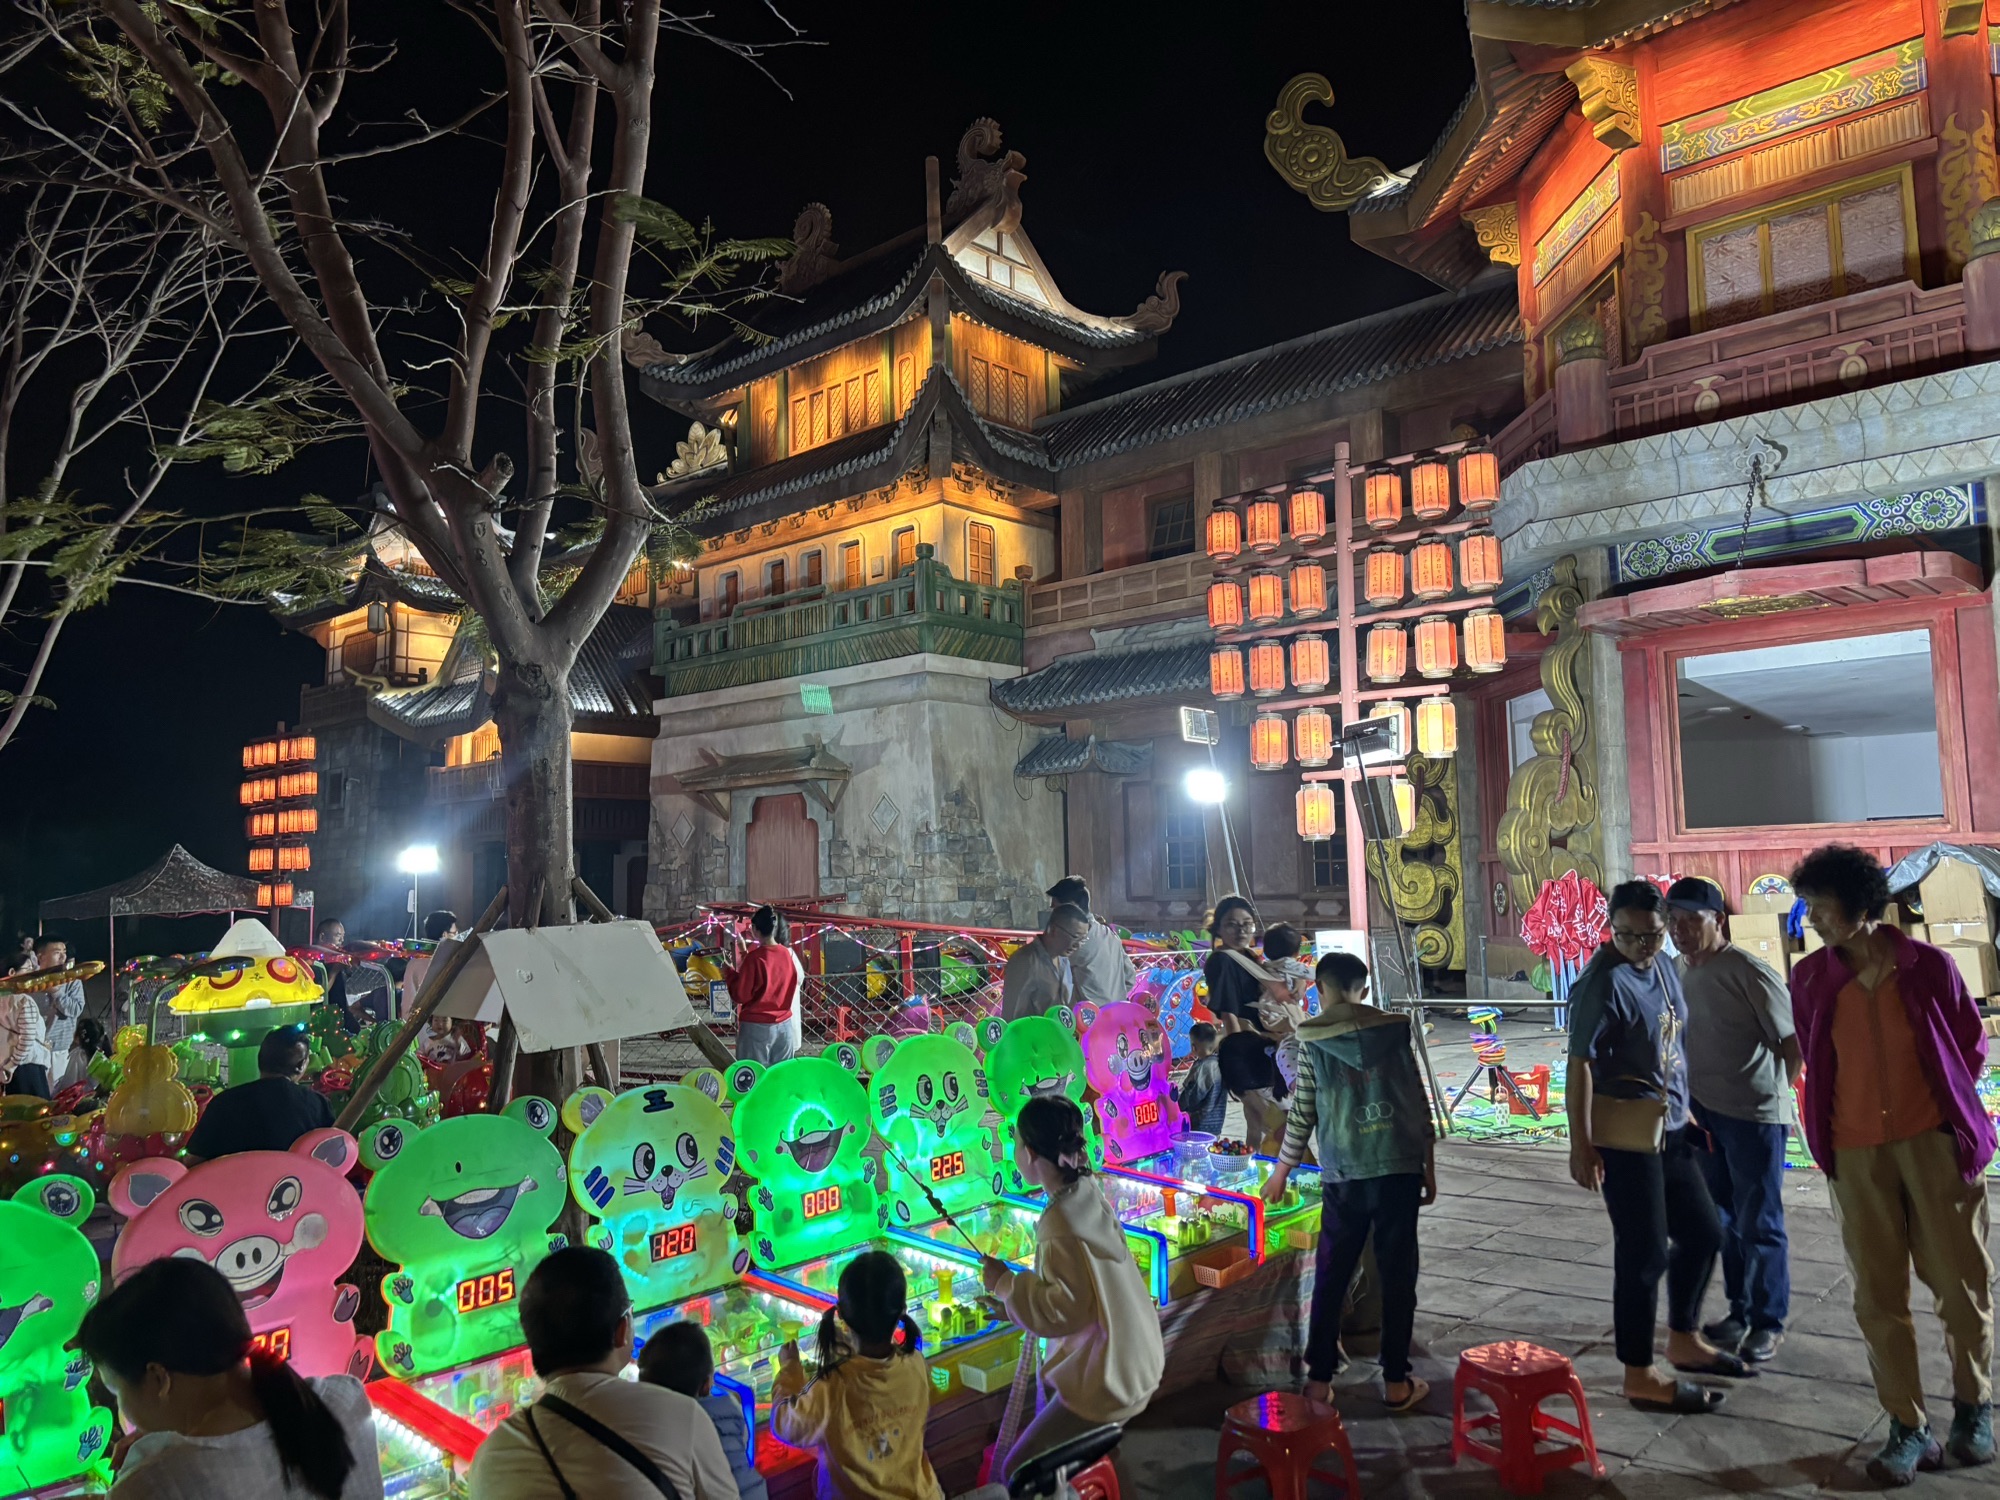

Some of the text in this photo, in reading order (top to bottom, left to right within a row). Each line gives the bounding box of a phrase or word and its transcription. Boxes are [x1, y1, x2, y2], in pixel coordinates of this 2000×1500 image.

[931, 1151, 963, 1181] 225
[804, 1186, 839, 1218] 000
[653, 1225, 695, 1260] 120
[458, 1270, 513, 1312] 005
